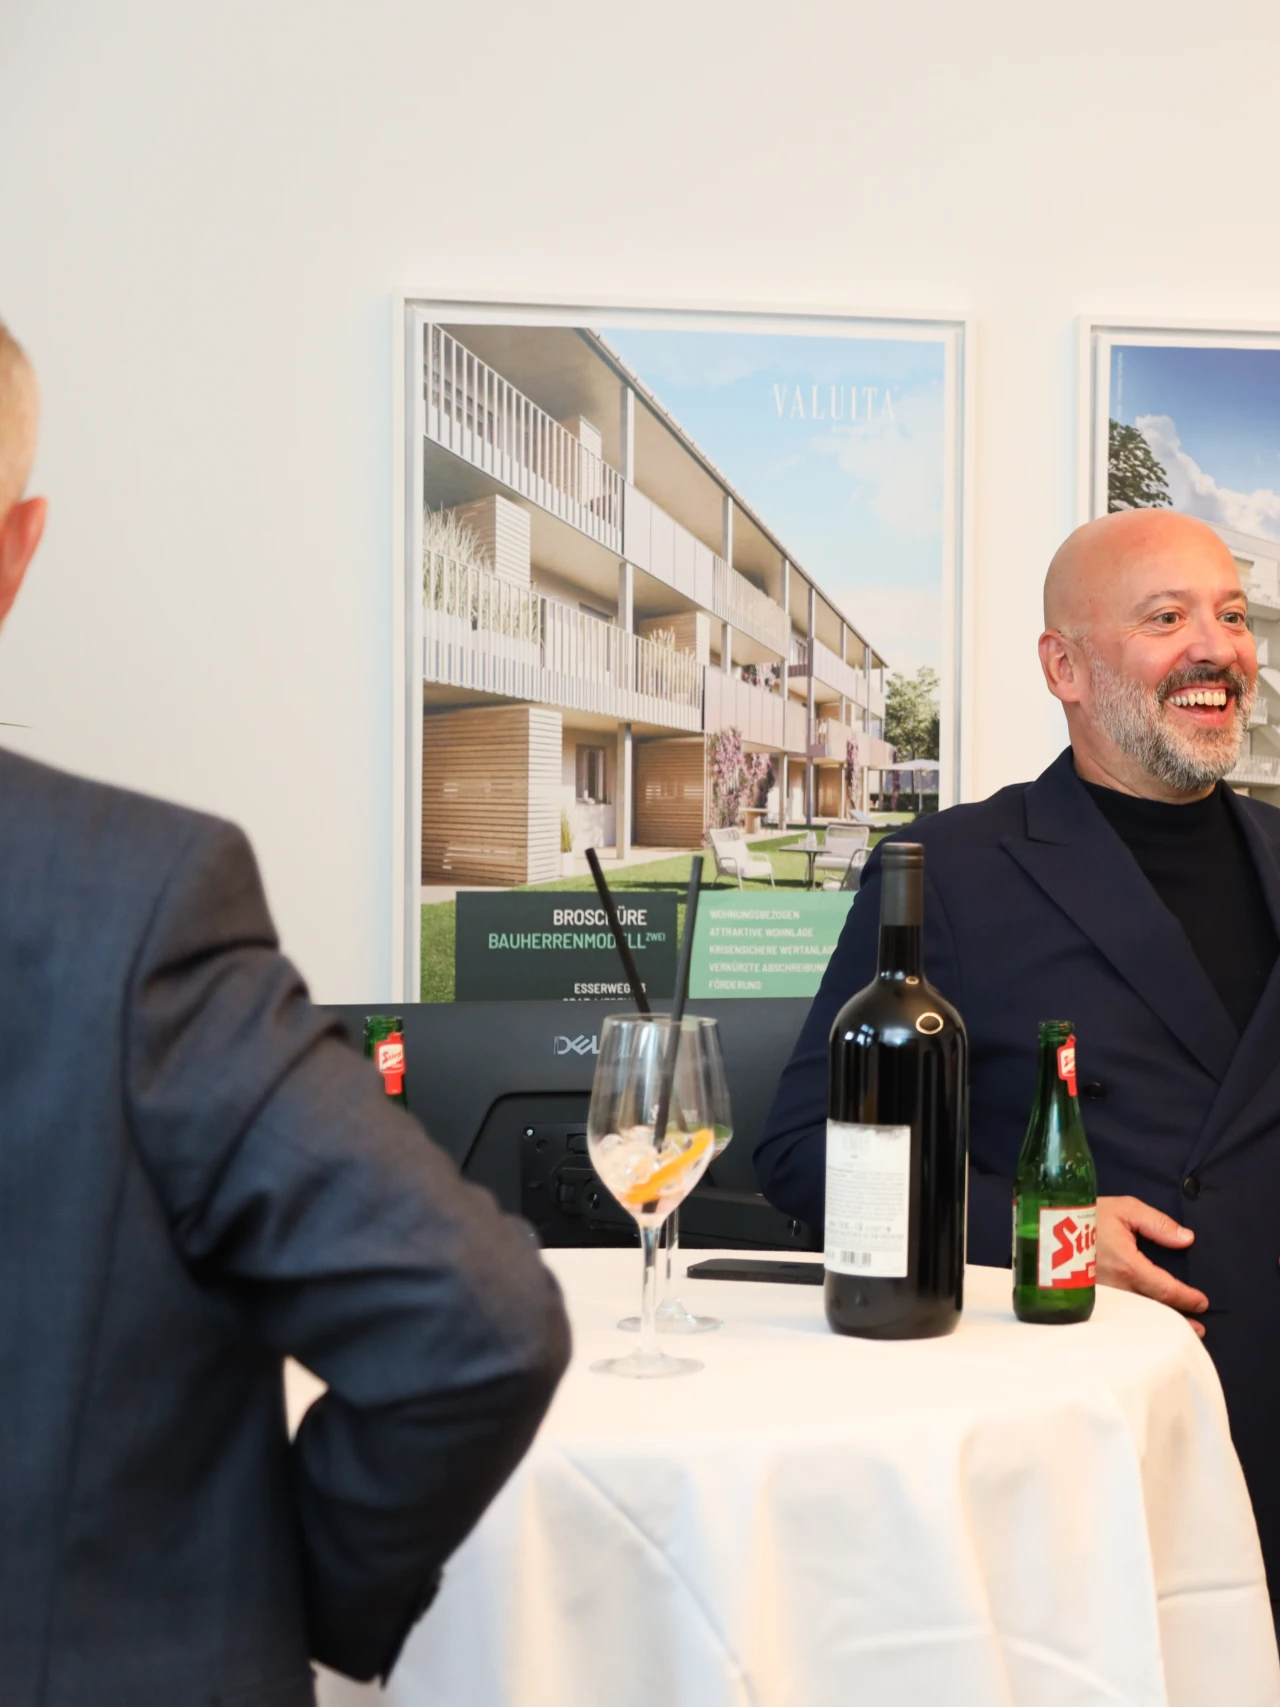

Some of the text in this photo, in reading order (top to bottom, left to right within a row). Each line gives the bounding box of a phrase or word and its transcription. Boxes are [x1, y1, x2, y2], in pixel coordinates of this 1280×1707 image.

[709, 927, 763, 938] ATTRAKTIVE
[488, 932, 646, 950] BAUHERRENMODLL
[574, 982, 631, 994] ESSERWEG
[554, 1035, 600, 1055] DEL
